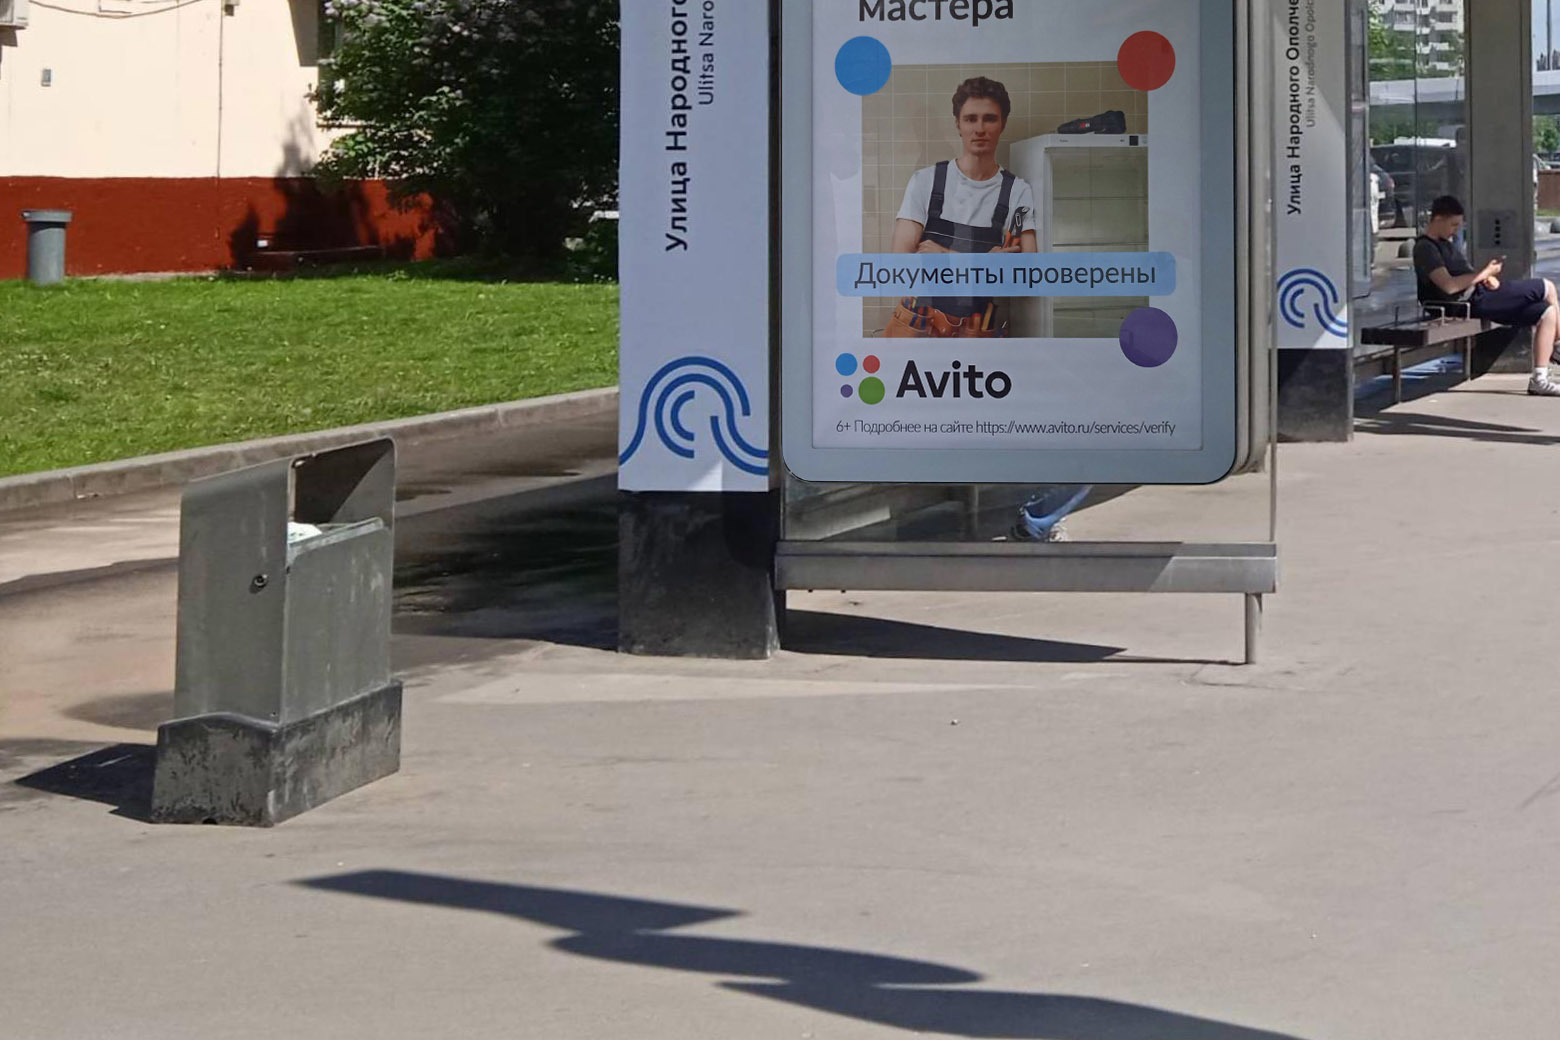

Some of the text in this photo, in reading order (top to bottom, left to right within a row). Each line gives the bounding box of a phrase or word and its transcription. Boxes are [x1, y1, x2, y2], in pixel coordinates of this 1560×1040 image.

[697, 52, 716, 106] Ulitsa
[1286, 65, 1302, 159] Народного
[664, 160, 692, 252] Улица
[1286, 164, 1302, 216] Улица
[854, 260, 1156, 290] Документы проверены
[895, 358, 1012, 400] Avito
[836, 419, 1176, 436] 6+ Подробнее на сайте https://www.avito.ru/services/verify
